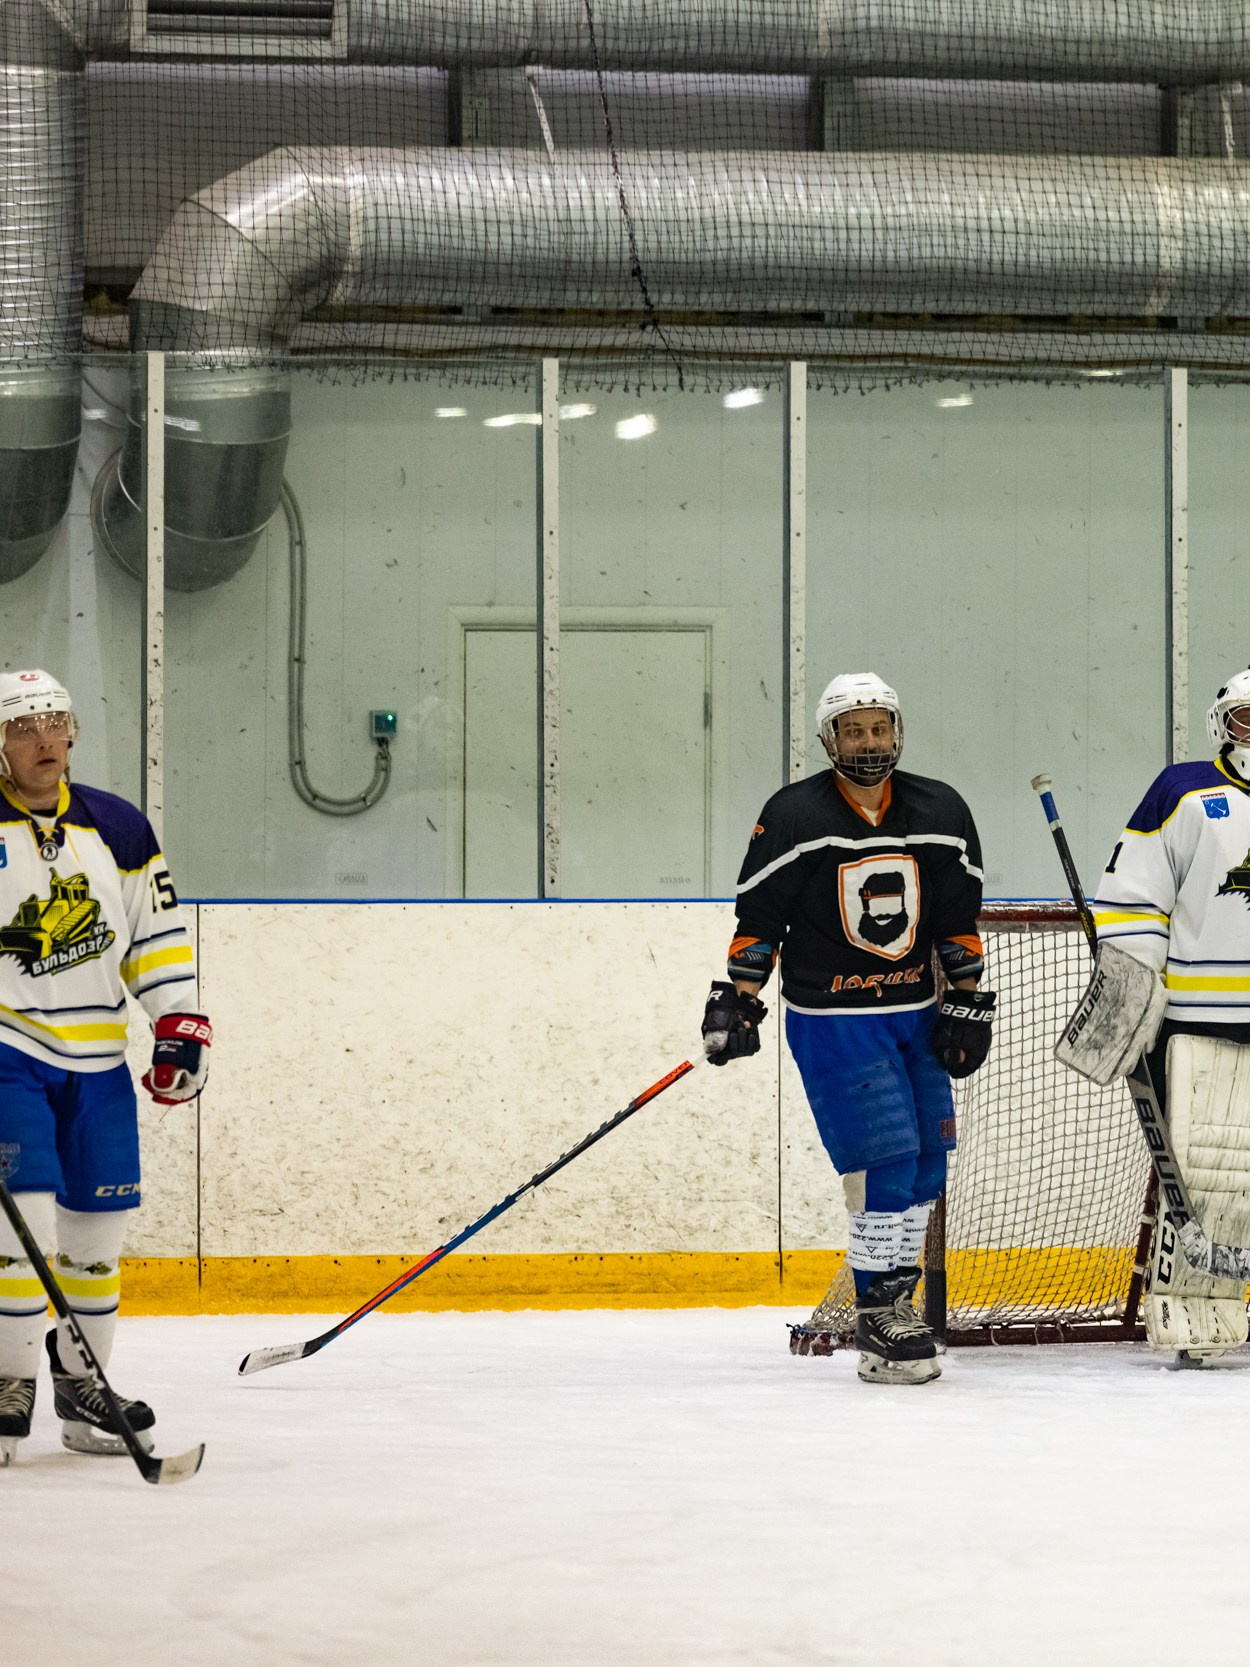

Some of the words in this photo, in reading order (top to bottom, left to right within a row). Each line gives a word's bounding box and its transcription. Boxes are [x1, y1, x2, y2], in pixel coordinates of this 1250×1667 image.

[1105, 841, 1124, 873] 1
[32, 935, 103, 975] БУЛЬДОЗР
[941, 1003, 994, 1022] BAUE
